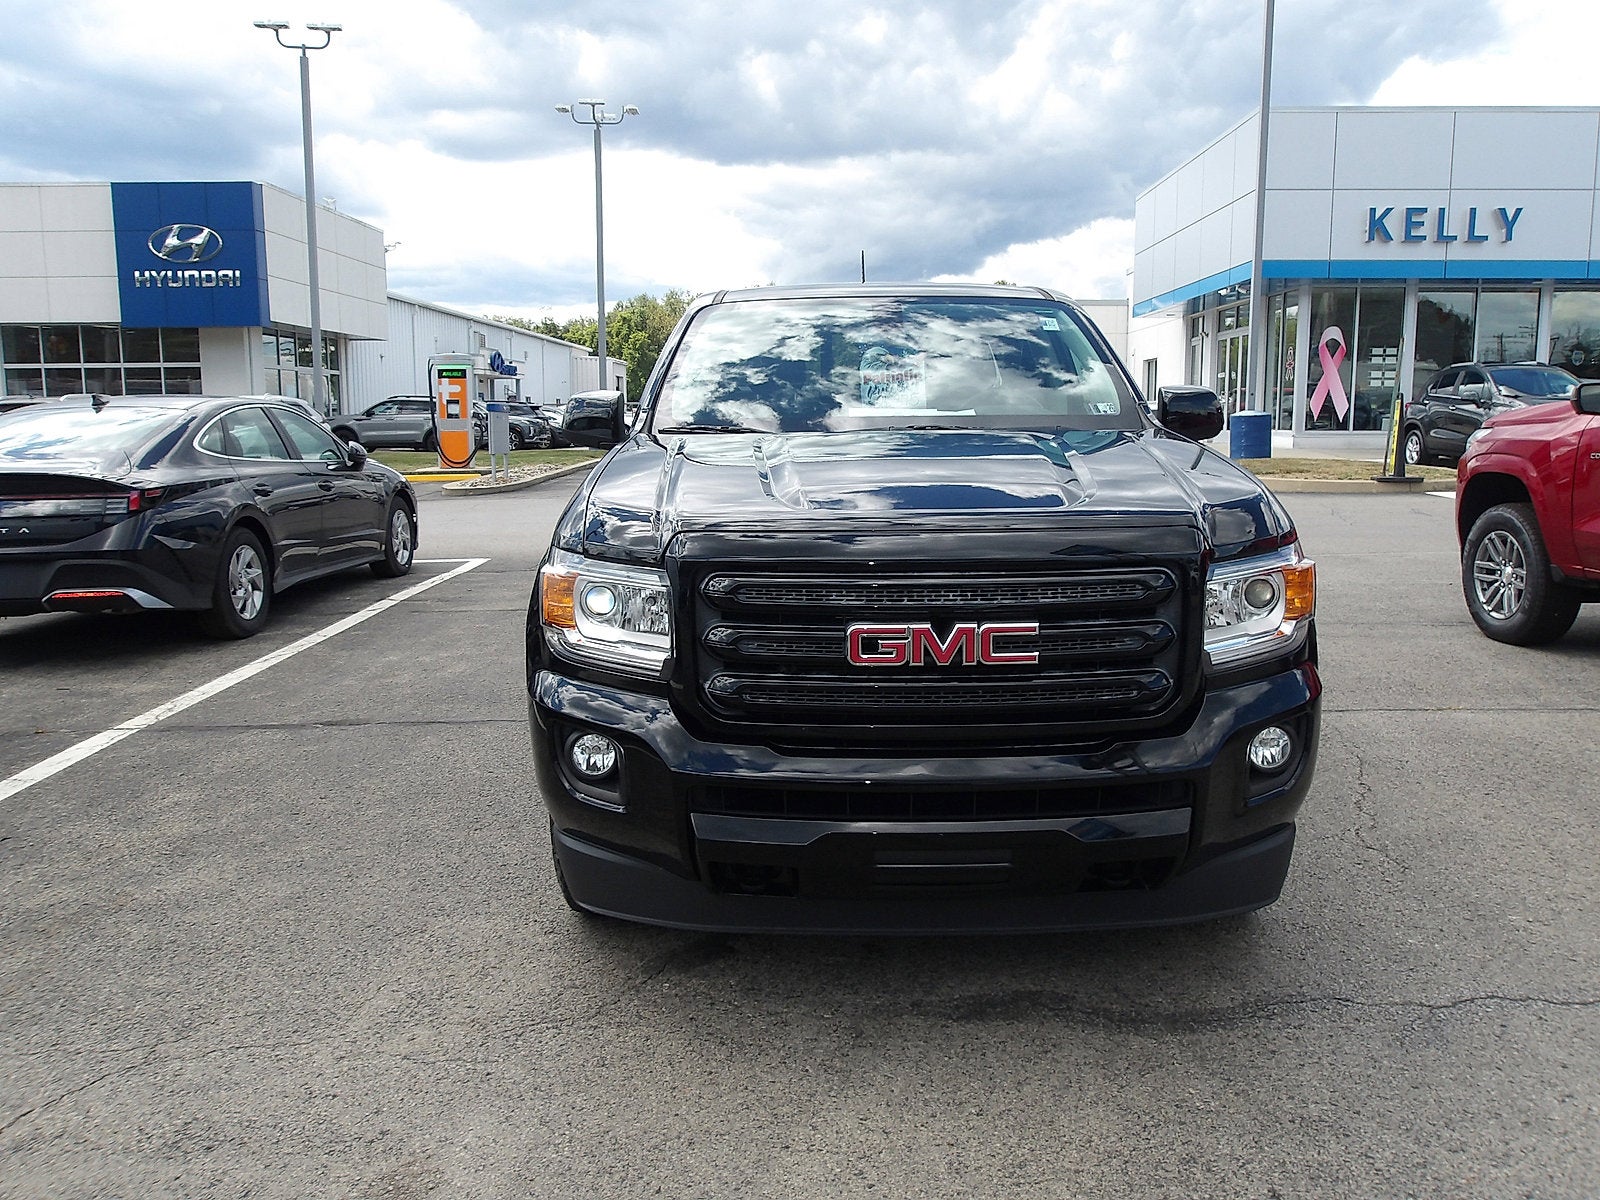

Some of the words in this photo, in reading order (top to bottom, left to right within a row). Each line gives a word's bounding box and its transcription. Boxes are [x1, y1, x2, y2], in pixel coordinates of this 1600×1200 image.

[1366, 207, 1523, 243] KELLY
[134, 270, 241, 288] HYUNDAI
[847, 623, 1039, 666] GMC
